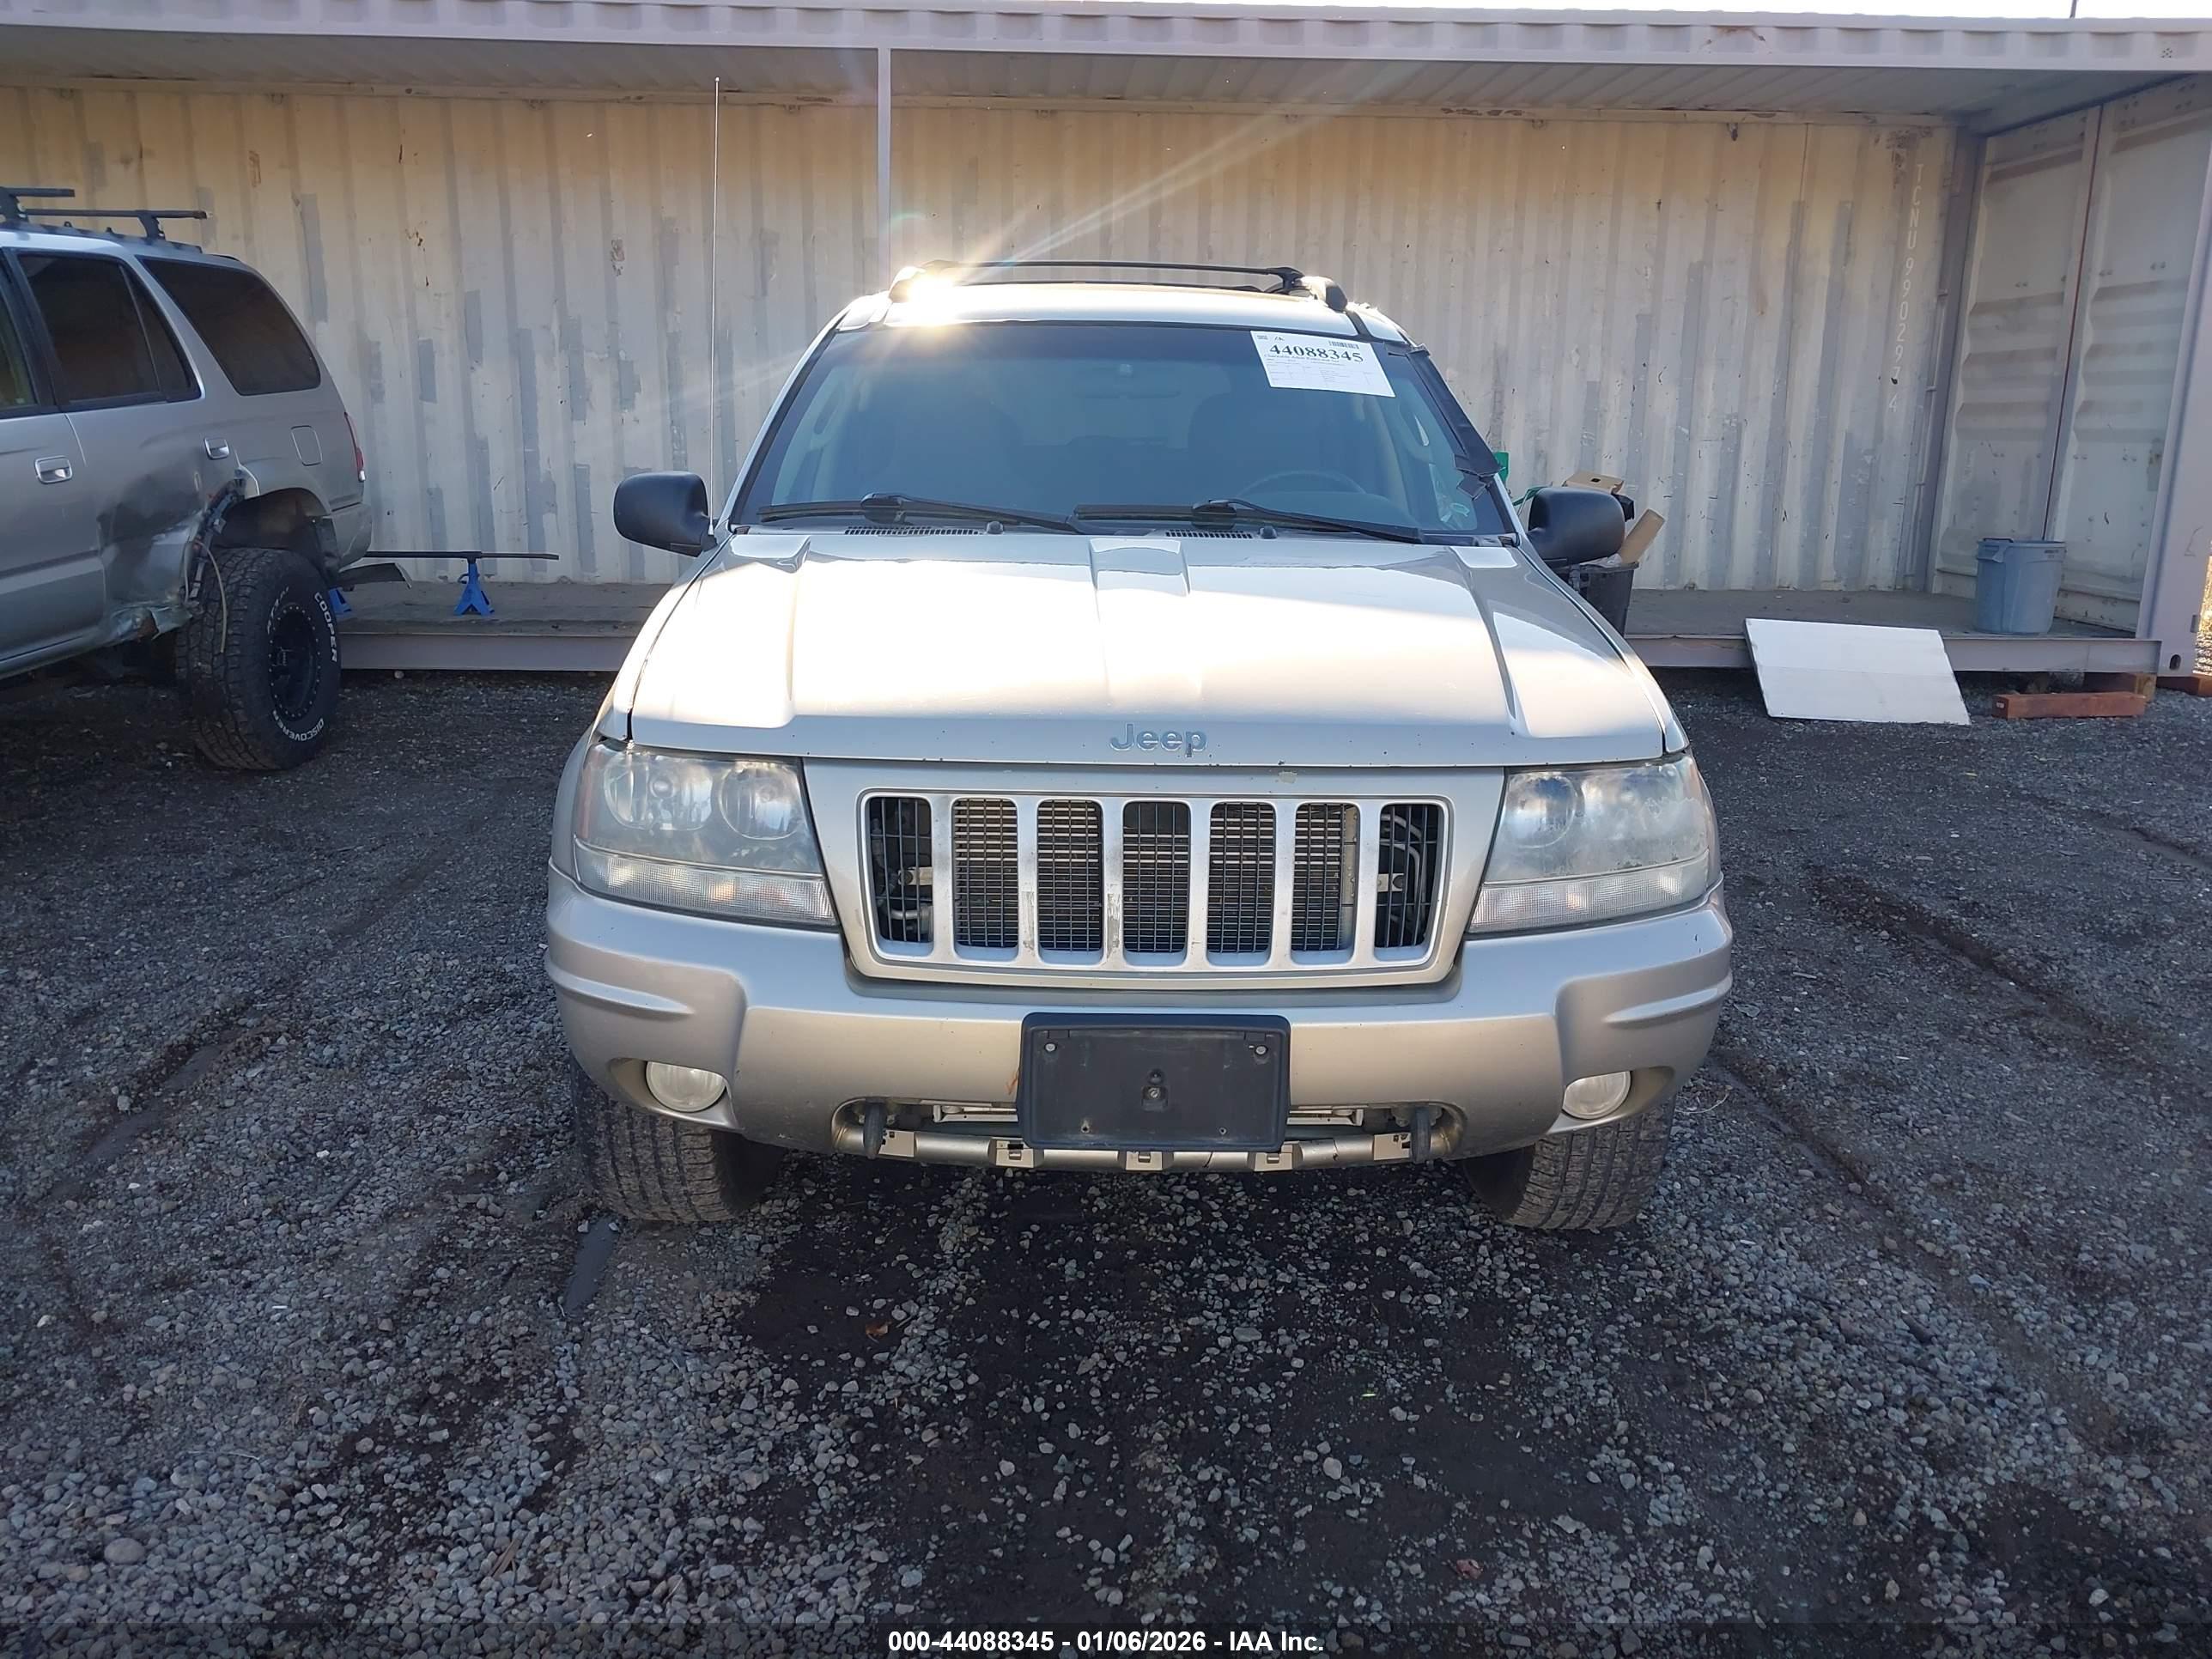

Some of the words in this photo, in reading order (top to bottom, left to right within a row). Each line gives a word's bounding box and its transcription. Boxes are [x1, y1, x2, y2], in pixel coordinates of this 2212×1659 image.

[1269, 343, 1364, 362] 44088345
[314, 592, 337, 663] COOPER
[1109, 723, 1208, 758] Jeep
